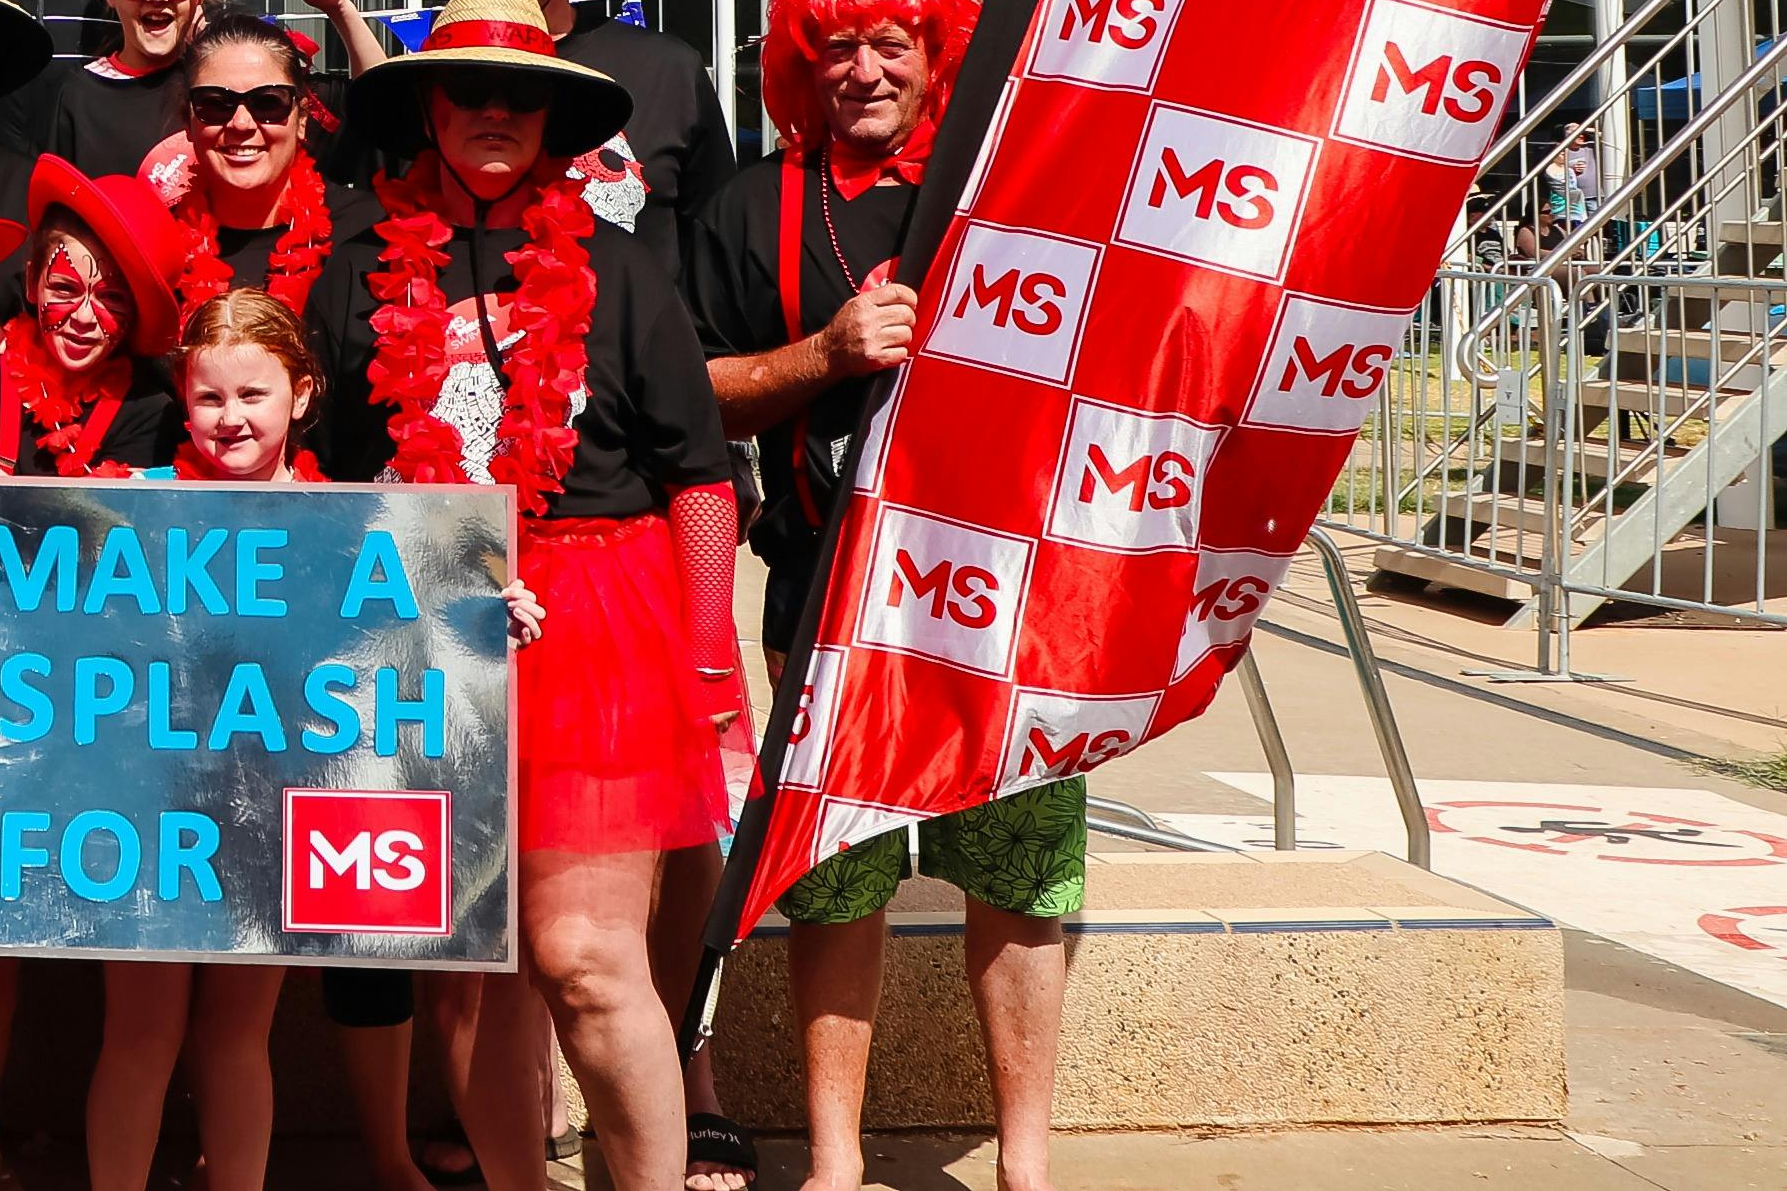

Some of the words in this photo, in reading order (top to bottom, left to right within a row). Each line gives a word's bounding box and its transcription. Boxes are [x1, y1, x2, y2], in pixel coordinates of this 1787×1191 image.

[1371, 41, 1502, 123] MS
[1148, 147, 1279, 230] MS
[952, 264, 1067, 337] MS
[1279, 336, 1394, 401] MS
[1078, 443, 1196, 513] MS
[340, 531, 419, 619] A
[886, 549, 1000, 629] MS
[1185, 575, 1269, 621] MS
[1018, 727, 1131, 779] MS
[0, 810, 223, 902] FOR
[309, 829, 427, 891] MS
